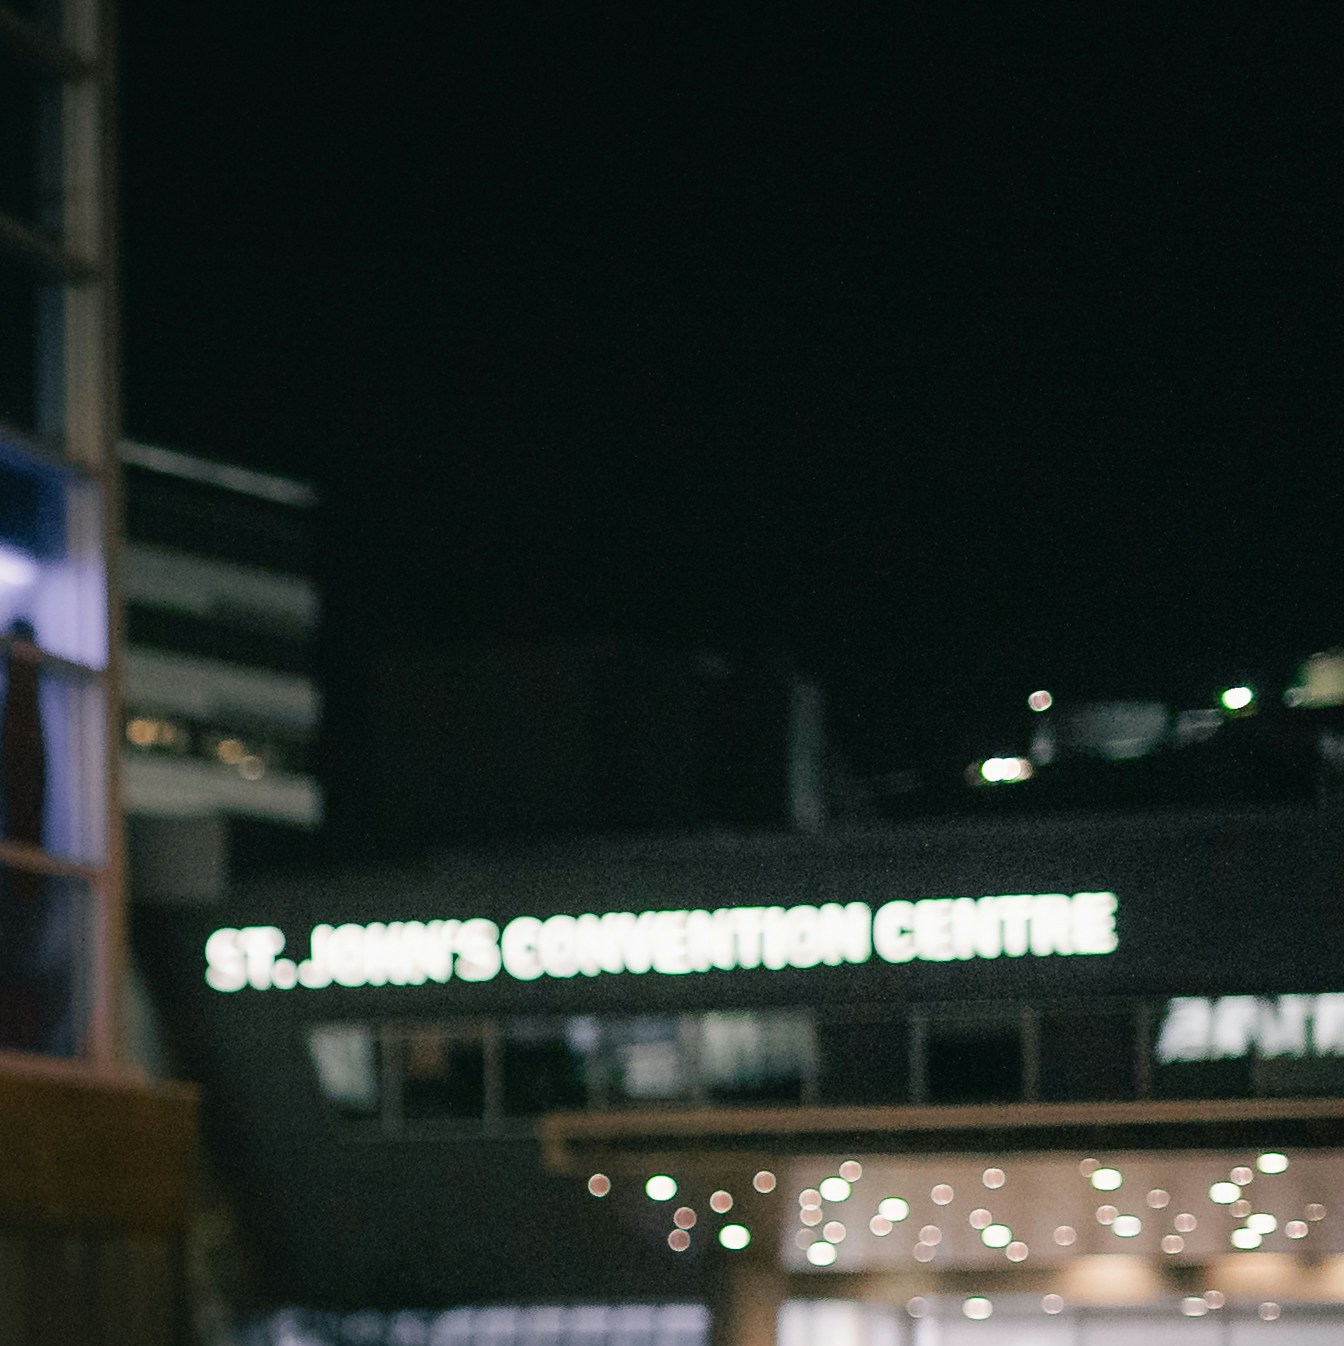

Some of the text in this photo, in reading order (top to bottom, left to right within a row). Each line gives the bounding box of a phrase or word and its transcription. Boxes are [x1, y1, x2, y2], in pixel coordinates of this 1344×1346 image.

[205, 892, 1118, 992] ST. JOHN'S CONVENTION CENTRE
